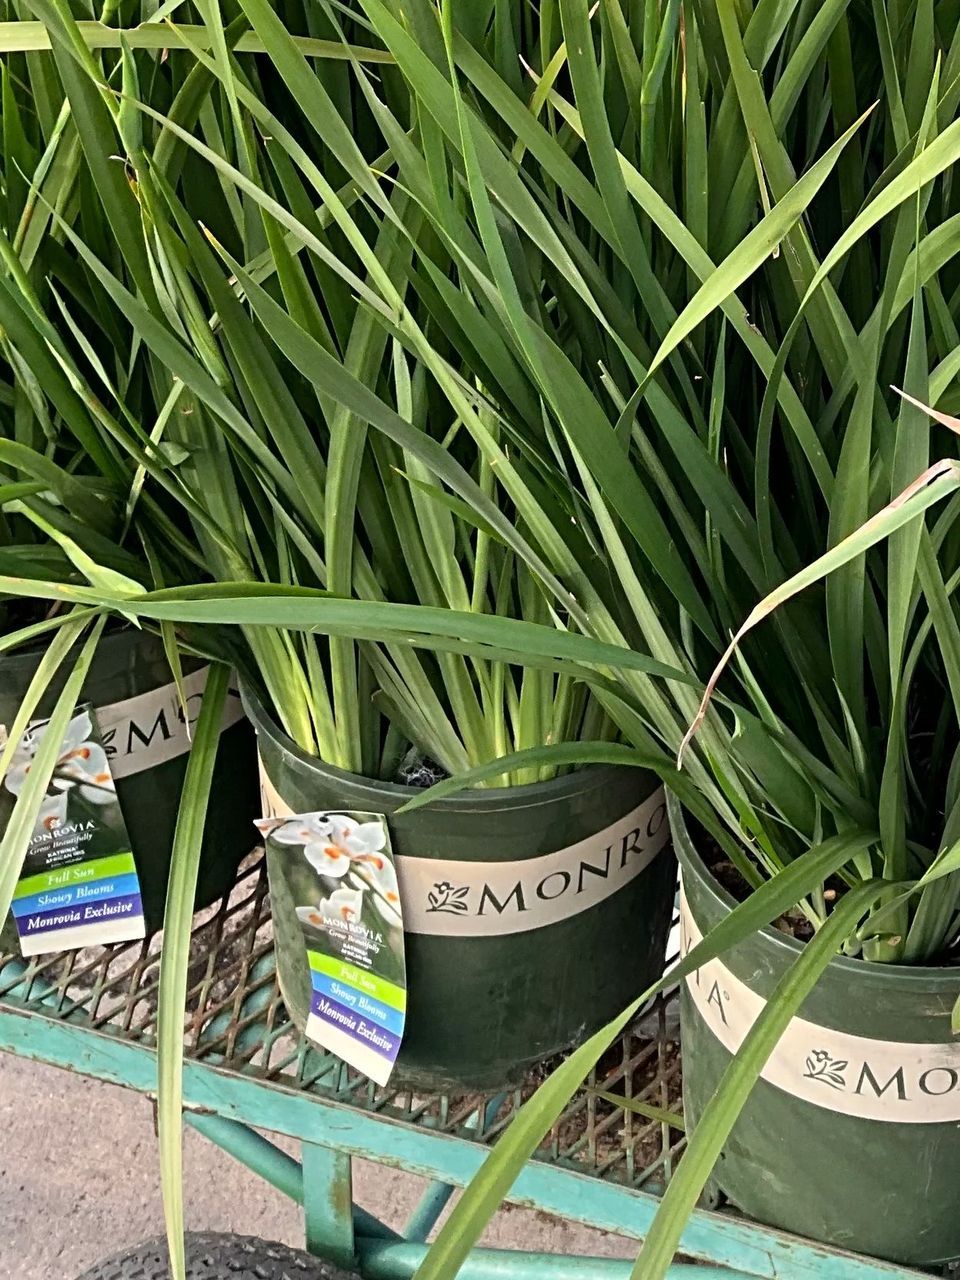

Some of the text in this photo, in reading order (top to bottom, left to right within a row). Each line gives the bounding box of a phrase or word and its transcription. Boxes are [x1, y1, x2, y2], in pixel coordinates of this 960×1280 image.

[29, 845, 51, 855] Grow
[47, 868, 95, 885] Full Sun
[37, 883, 114, 907] Showy Blooms
[27, 902, 133, 930] Monrovia Exclusive
[329, 982, 387, 1020] Showy Blooms
[317, 999, 393, 1052] Monrovia Exclusive
